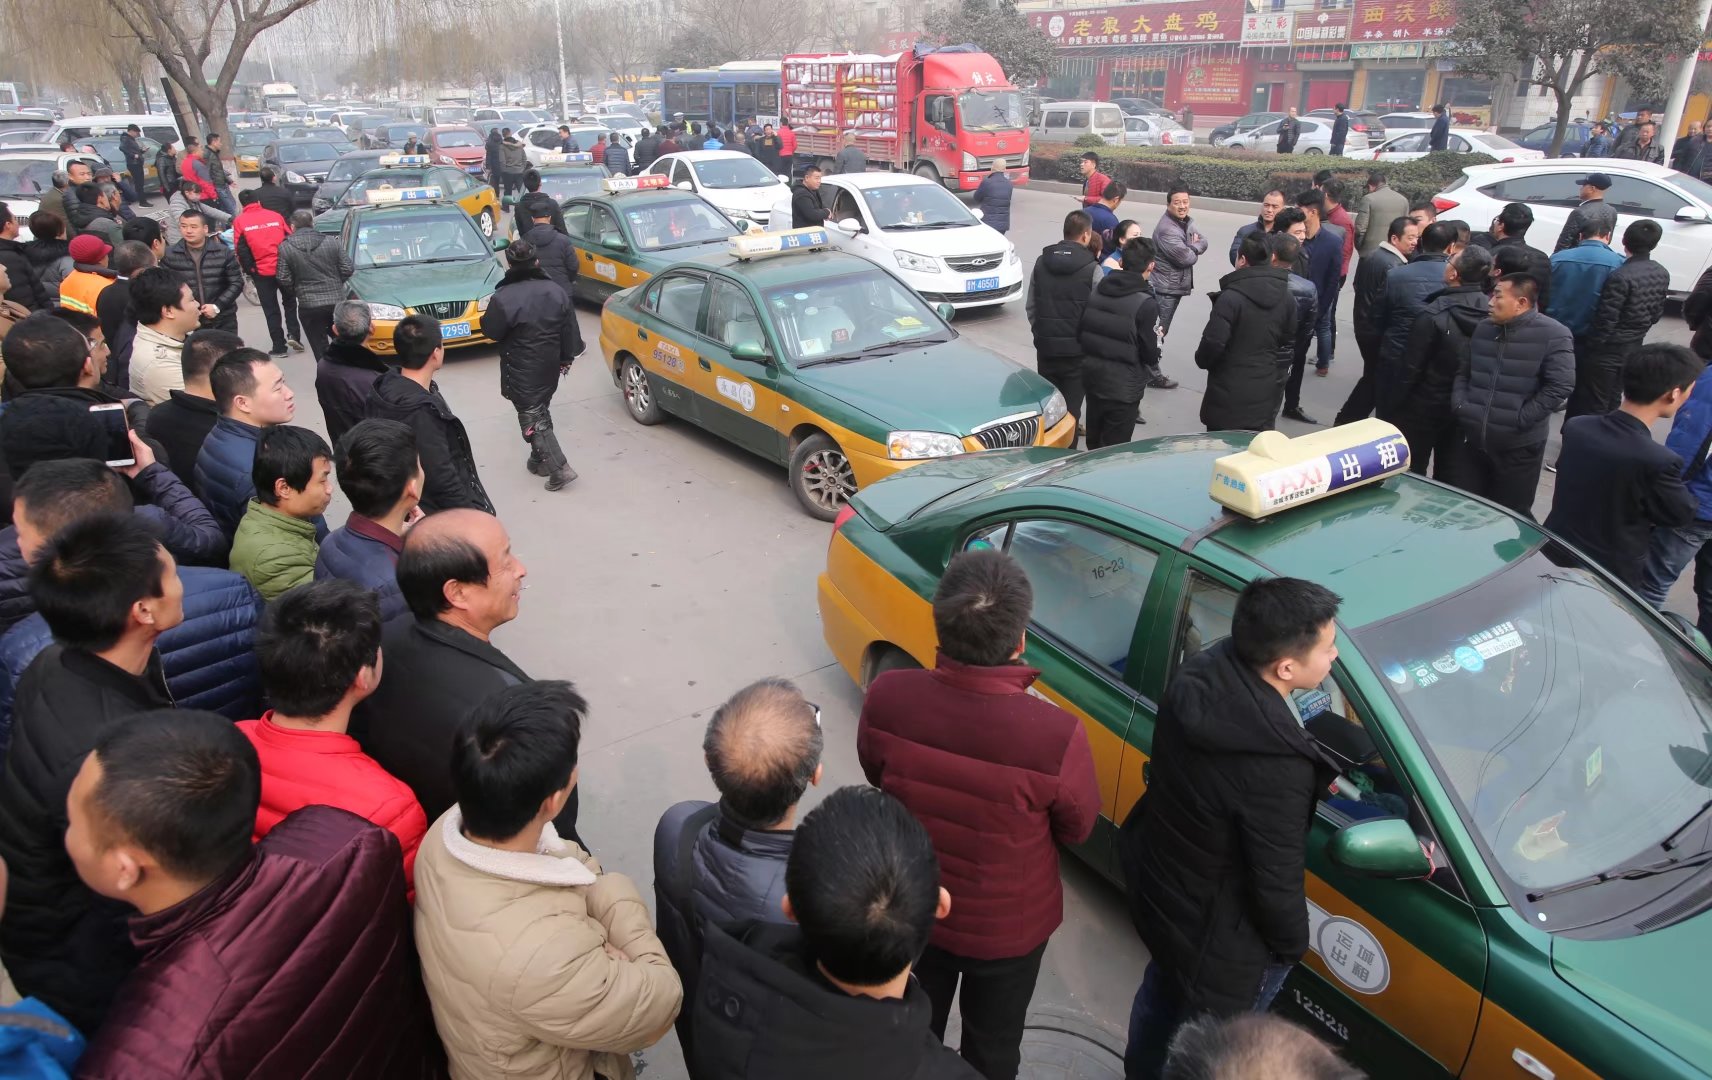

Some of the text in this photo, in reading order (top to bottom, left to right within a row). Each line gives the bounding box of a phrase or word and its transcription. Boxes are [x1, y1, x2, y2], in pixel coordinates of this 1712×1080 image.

[1296, 26, 1347, 40] 中国福利彩票
[786, 232, 823, 248] 出租
[653, 349, 677, 368] 95128
[659, 343, 677, 354] TAXI
[1339, 442, 1401, 482] 出租
[1091, 556, 1125, 580] 16-23
[1418, 672, 1440, 688] 2018
[1336, 929, 1376, 967] 运城
[1330, 945, 1370, 984] 出租
[1293, 988, 1351, 1041] 12328
